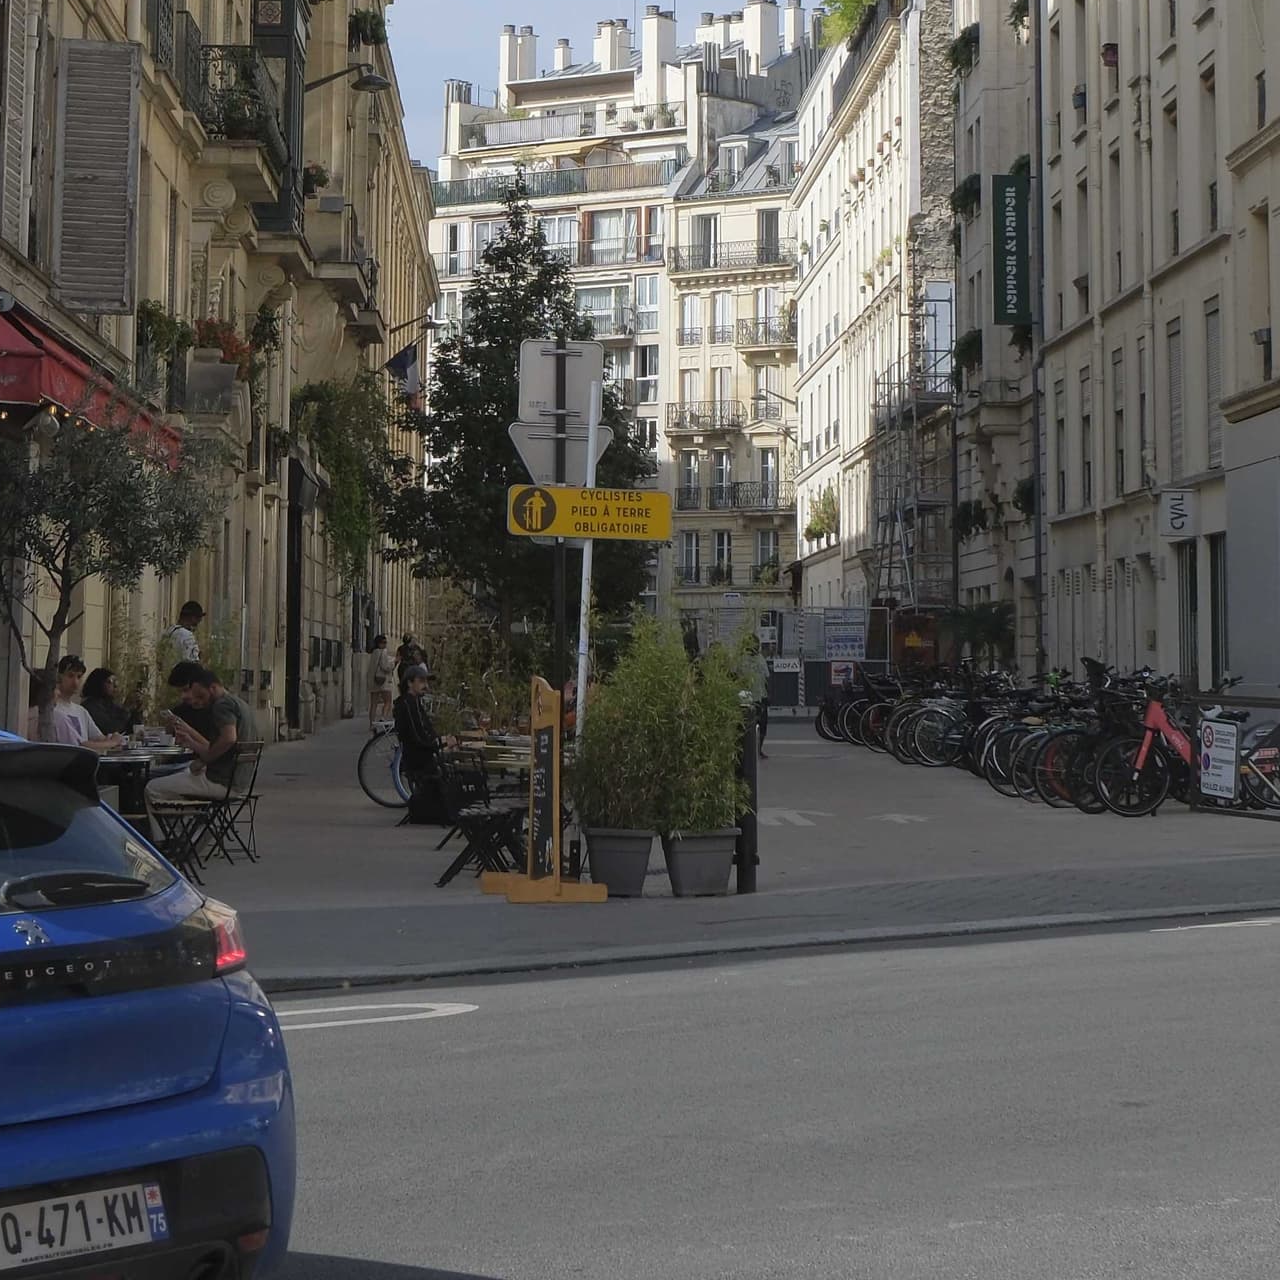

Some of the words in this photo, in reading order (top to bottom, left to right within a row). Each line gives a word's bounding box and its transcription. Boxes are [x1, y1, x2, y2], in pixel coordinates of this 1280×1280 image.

[581, 490, 643, 502] CYCLISTES
[571, 506, 598, 517] PIED
[603, 504, 610, 517] À
[615, 507, 652, 518] TERRE
[574, 523, 649, 534] OBLIGATOIRE
[149, 1213, 167, 1233] 75
